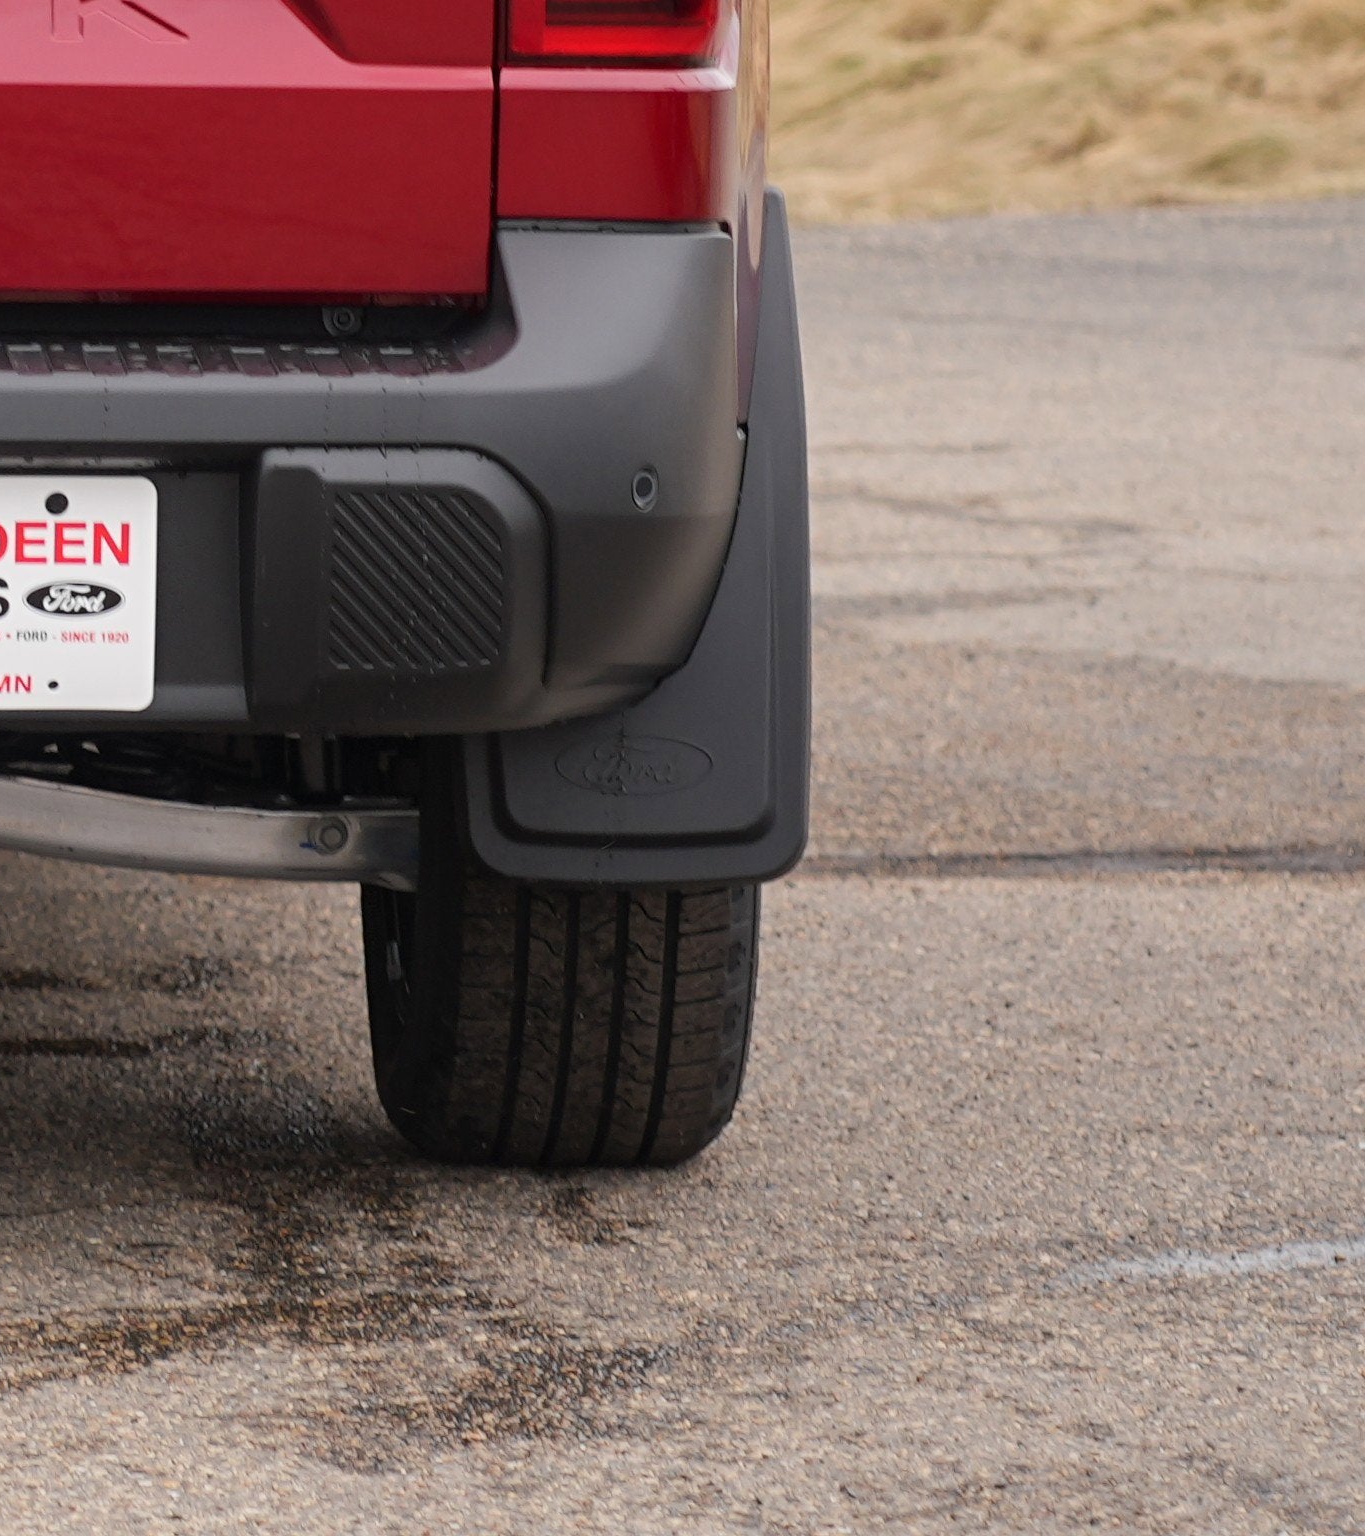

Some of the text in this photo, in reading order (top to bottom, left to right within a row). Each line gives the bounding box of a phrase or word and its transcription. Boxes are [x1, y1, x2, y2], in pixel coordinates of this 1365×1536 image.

[42, 584, 107, 613] Ford
[16, 630, 49, 642] FORD
[61, 631, 97, 643] SINCE
[102, 631, 130, 644] 1920
